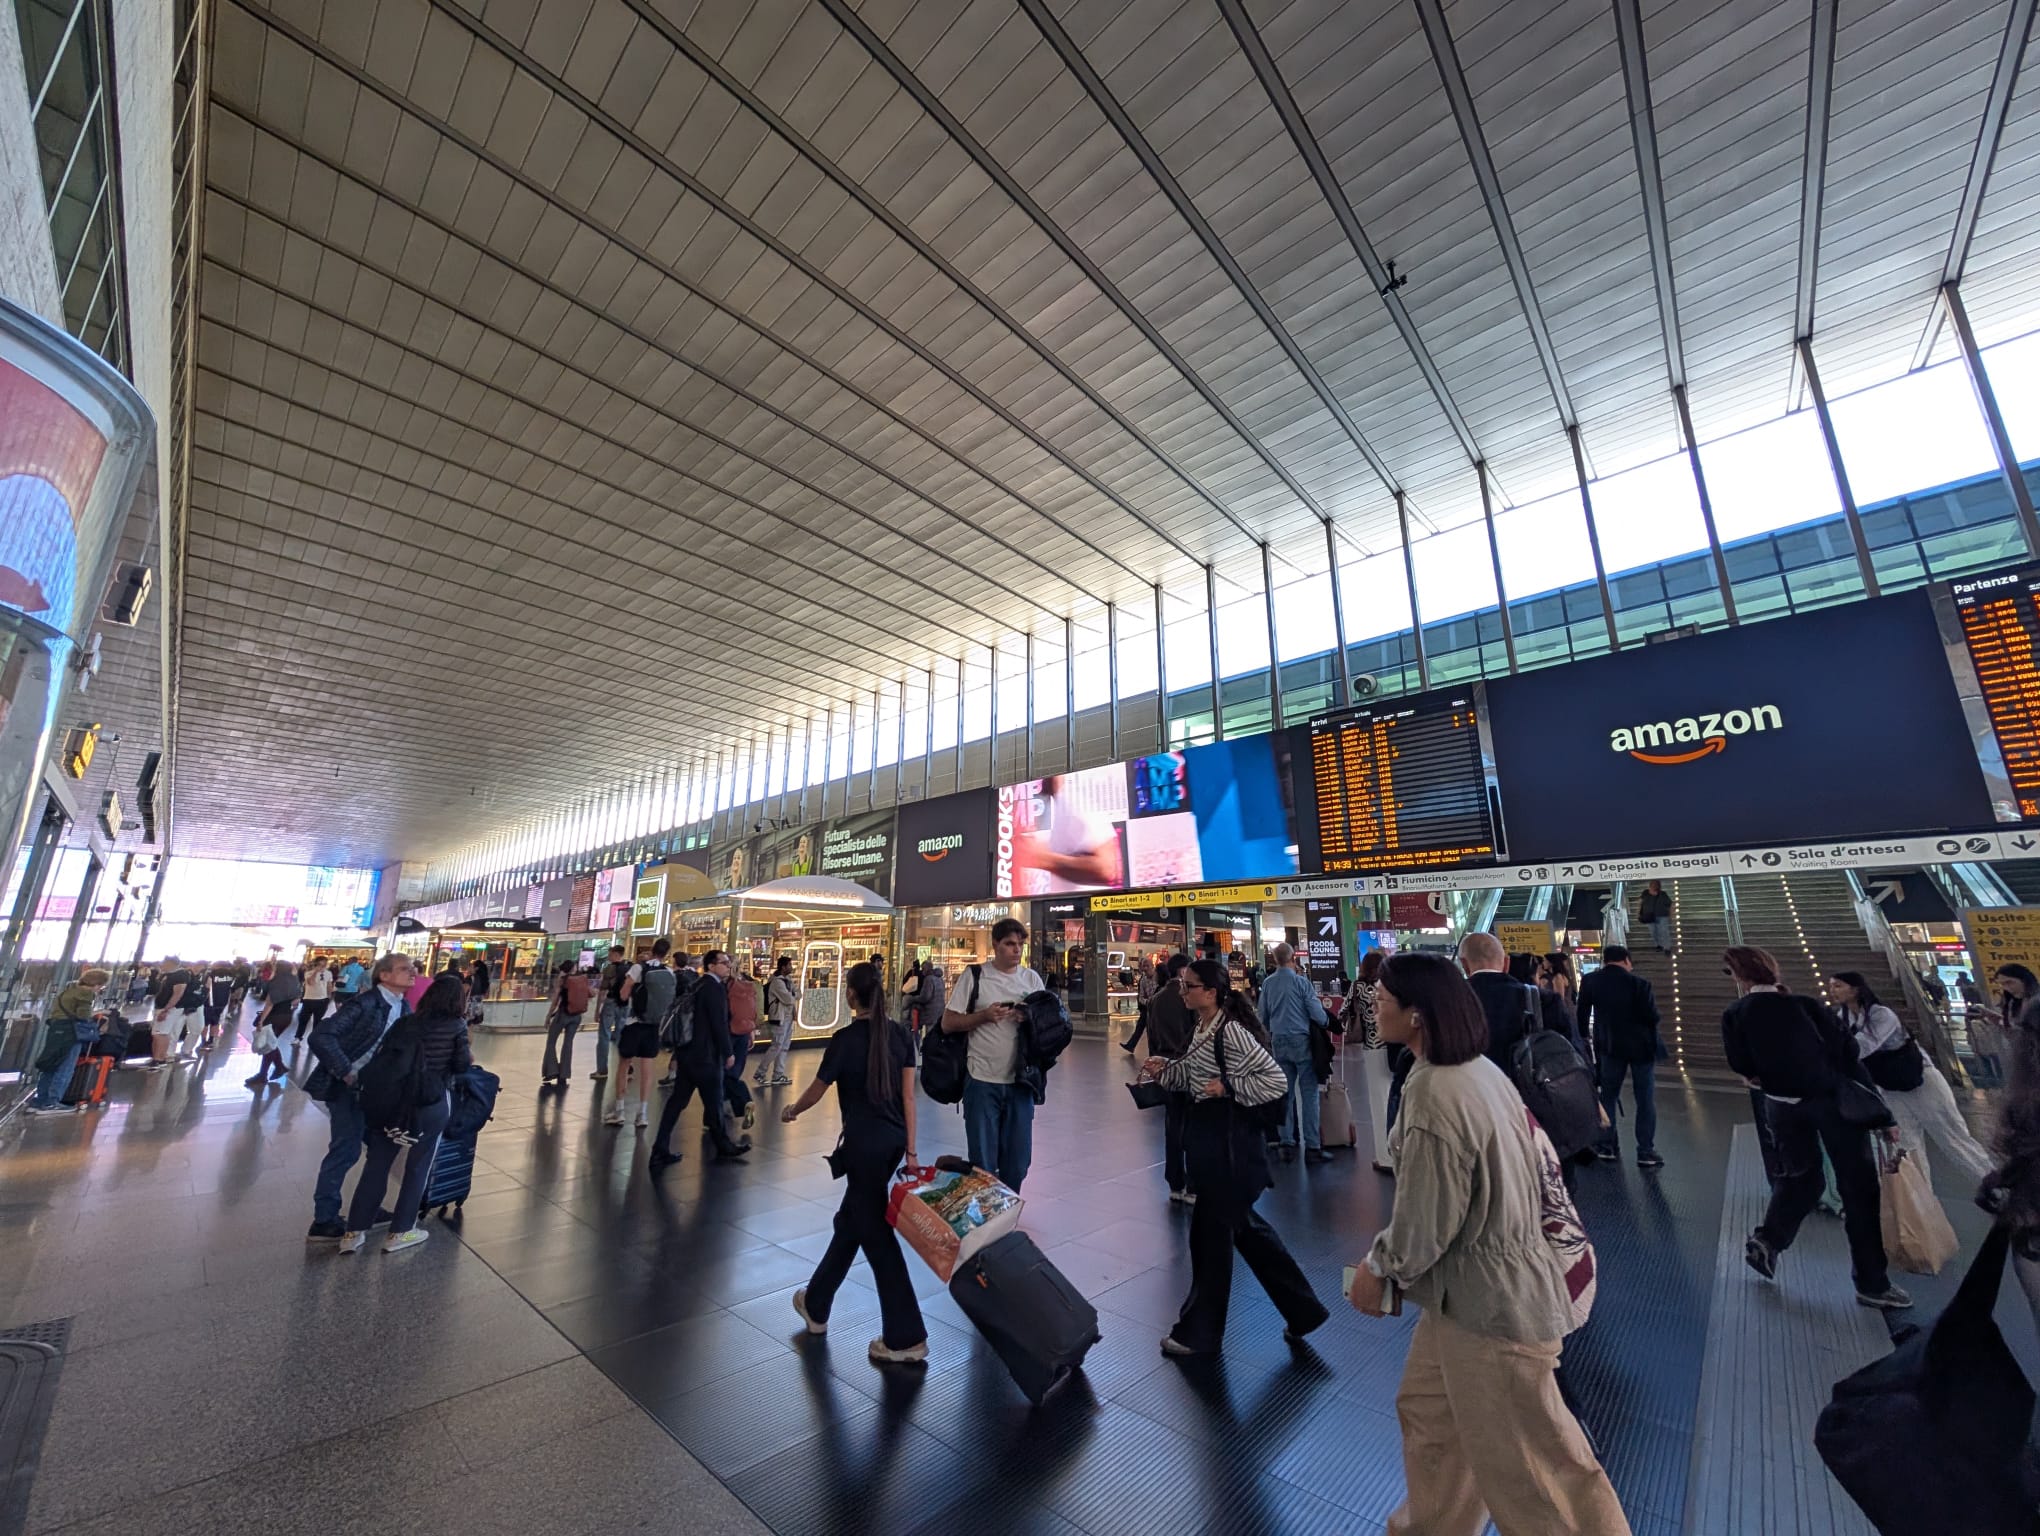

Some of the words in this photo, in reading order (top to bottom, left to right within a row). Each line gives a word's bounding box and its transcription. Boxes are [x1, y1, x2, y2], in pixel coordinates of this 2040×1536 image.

[1953, 574, 2018, 594] Partenze
[1311, 718, 1328, 727] Arrivi
[1610, 704, 1783, 752] amazon
[824, 829, 850, 844] Futura
[918, 833, 963, 853] amazon
[996, 786, 1014, 898] BROOKS
[822, 838, 866, 857] specialista
[866, 834, 887, 849] delle
[1788, 848, 1826, 860] Sala
[1830, 845, 1906, 857] d'attesa
[822, 856, 852, 870] Risorse
[852, 852, 884, 866] Umane.
[1598, 860, 1658, 872] Deposito
[1662, 856, 1719, 868] Bagagli
[1790, 860, 1828, 868] Waiting
[1305, 881, 1350, 891] Ascensore
[1402, 875, 1448, 884] Fiumicino
[1110, 896, 1128, 904] Binari
[1199, 890, 1220, 898] Binari
[1990, 952, 2029, 960] Treni
